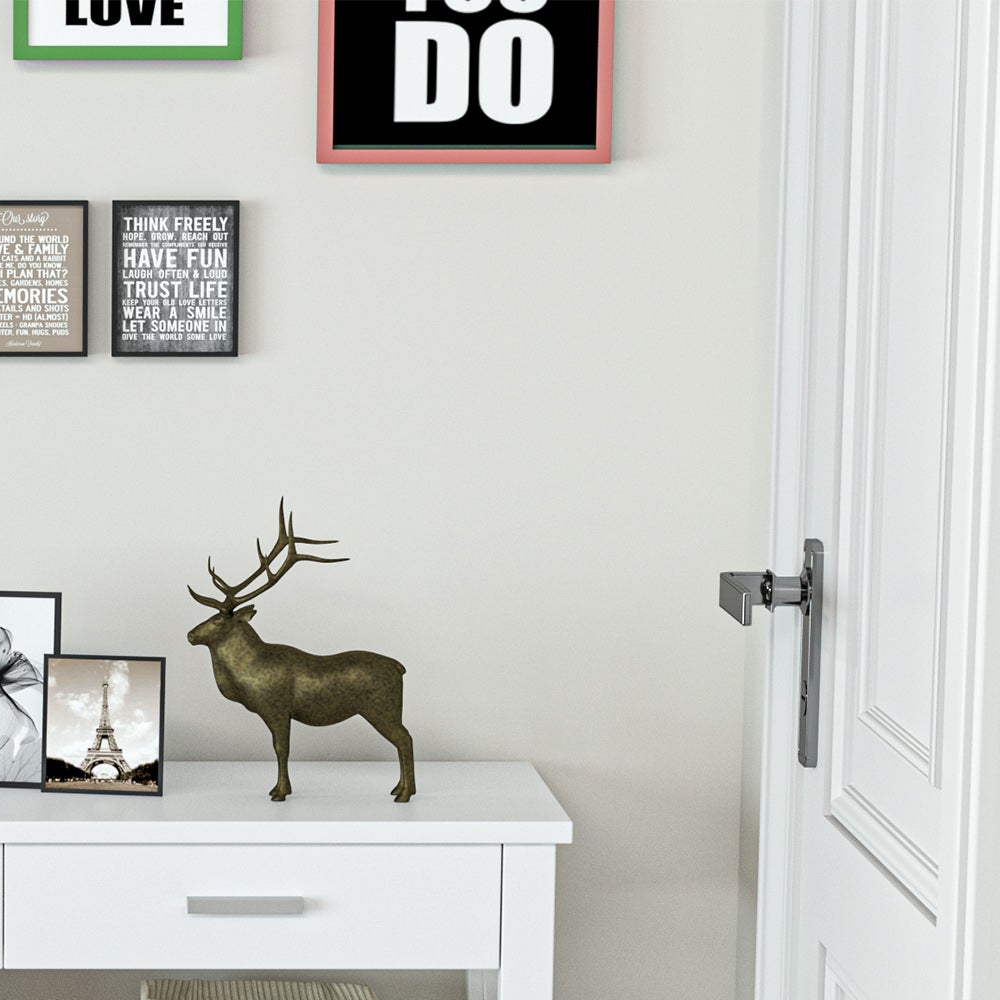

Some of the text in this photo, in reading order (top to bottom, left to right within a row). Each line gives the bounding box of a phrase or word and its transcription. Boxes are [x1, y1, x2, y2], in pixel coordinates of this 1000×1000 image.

[394, 18, 554, 125] DO
[26, 210, 49, 226] story
[124, 217, 227, 231] THINK FREELY
[20, 235, 35, 243] THE
[38, 235, 69, 243] WORLD
[15, 244, 23, 254] &
[28, 244, 69, 254] FAMILY
[124, 249, 227, 268] HAVE FUN
[0, 270, 3, 278] I
[7, 270, 33, 278] PLAN
[36, 270, 68, 278] THAT?
[123, 270, 227, 278] LAUGH OFTEN & LOUD
[123, 281, 227, 298] TRUST LIFE
[23, 313, 32, 321] HD
[35, 313, 68, 321] (ALMOST)
[123, 307, 226, 319] WEAR A SMILE
[122, 320, 226, 332] LET SOMEONE IN
